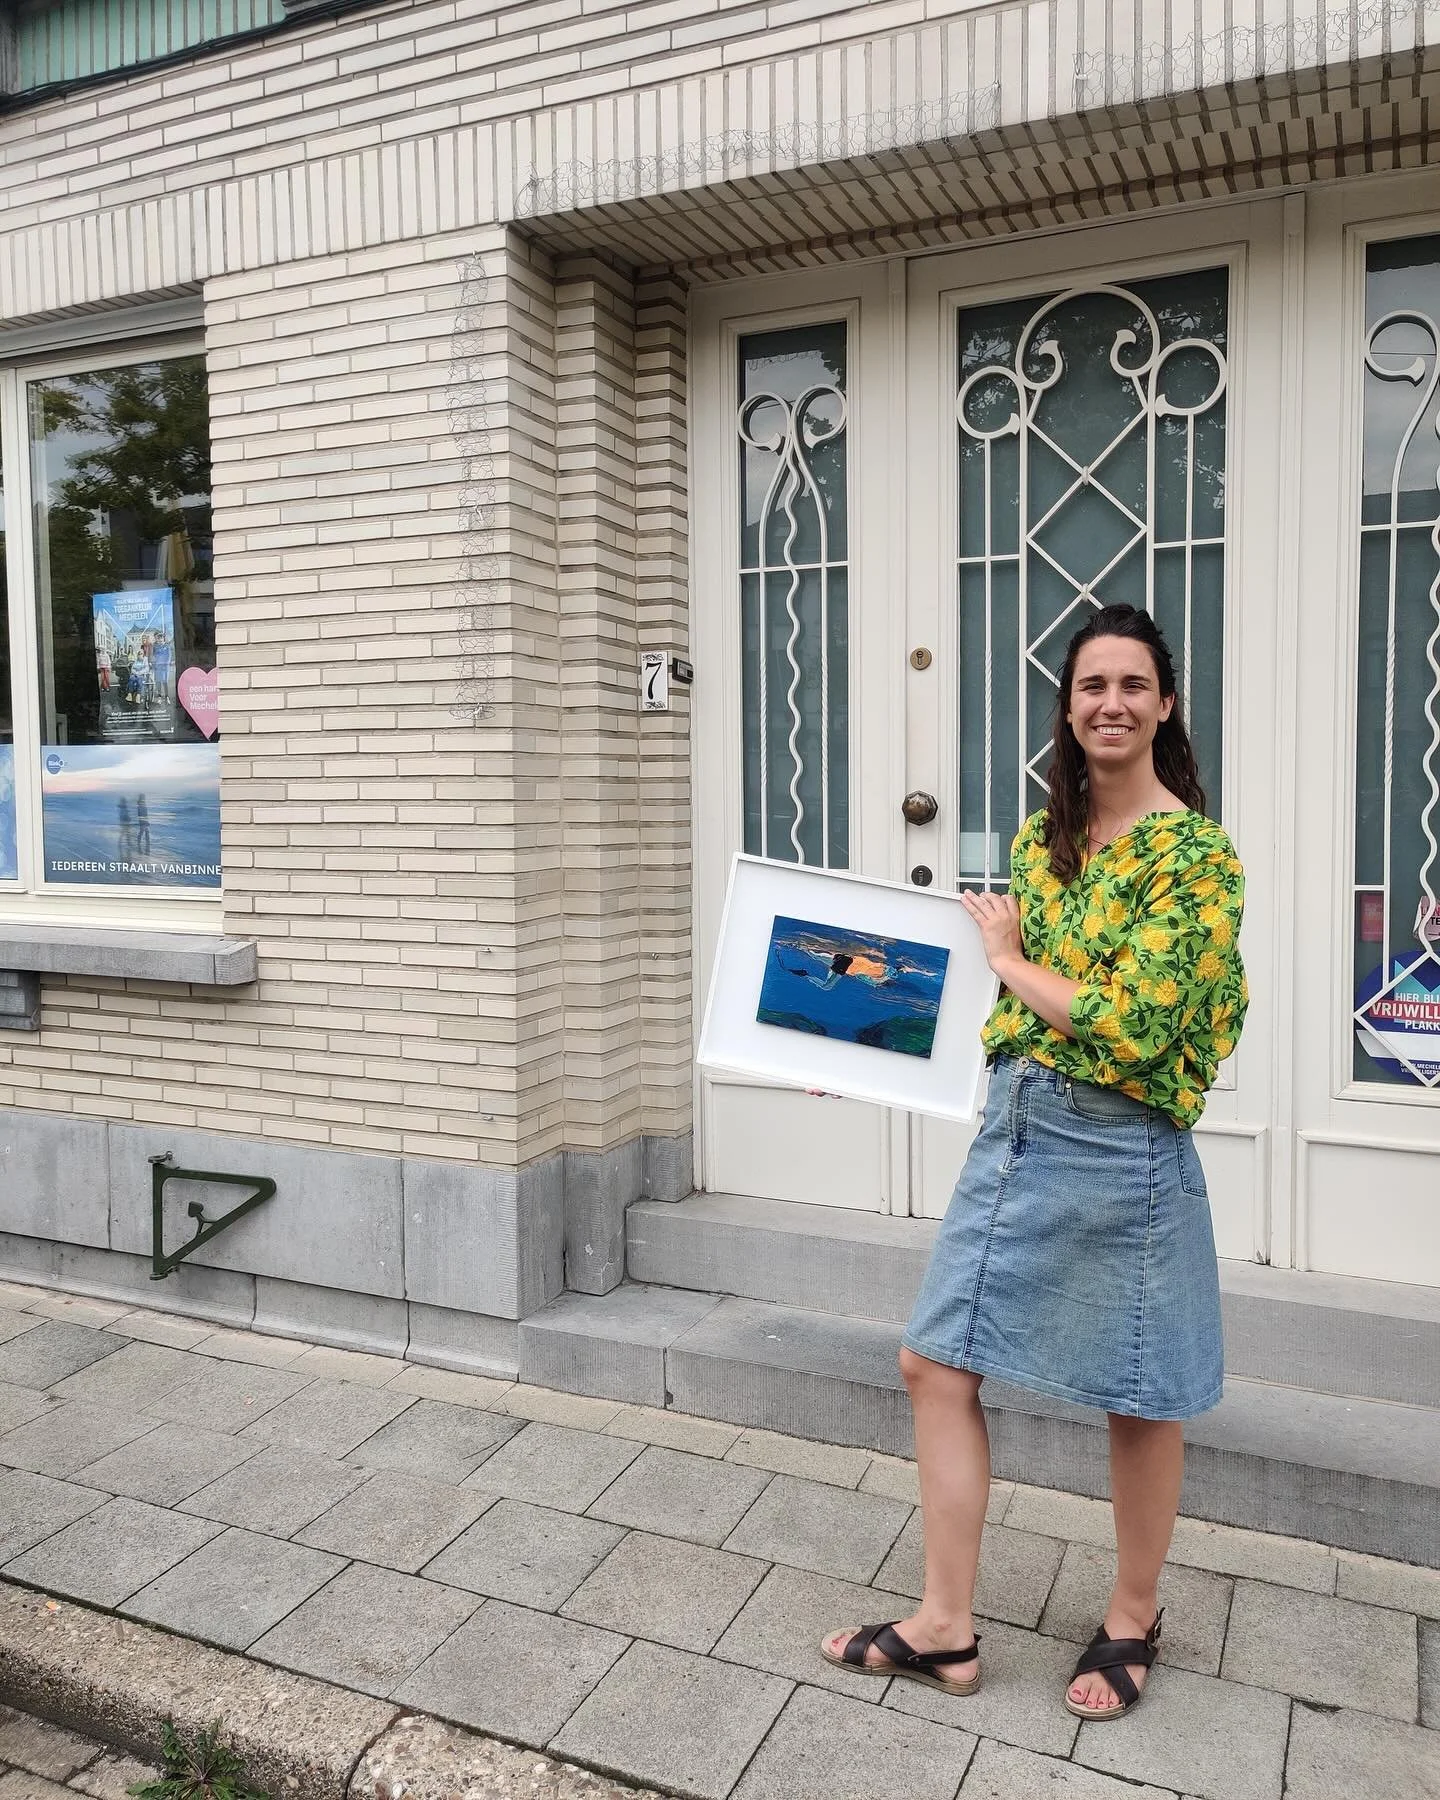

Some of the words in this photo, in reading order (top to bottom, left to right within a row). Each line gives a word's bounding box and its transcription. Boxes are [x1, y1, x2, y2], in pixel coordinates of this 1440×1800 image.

[645, 661, 663, 700] 7
[52, 860, 106, 872] IEDEREEN
[109, 862, 157, 873] STRAALT
[161, 863, 222, 875] VANBINNE
[1395, 992, 1420, 1003] HIER
[1371, 1002, 1440, 1020] VRIJWILL
